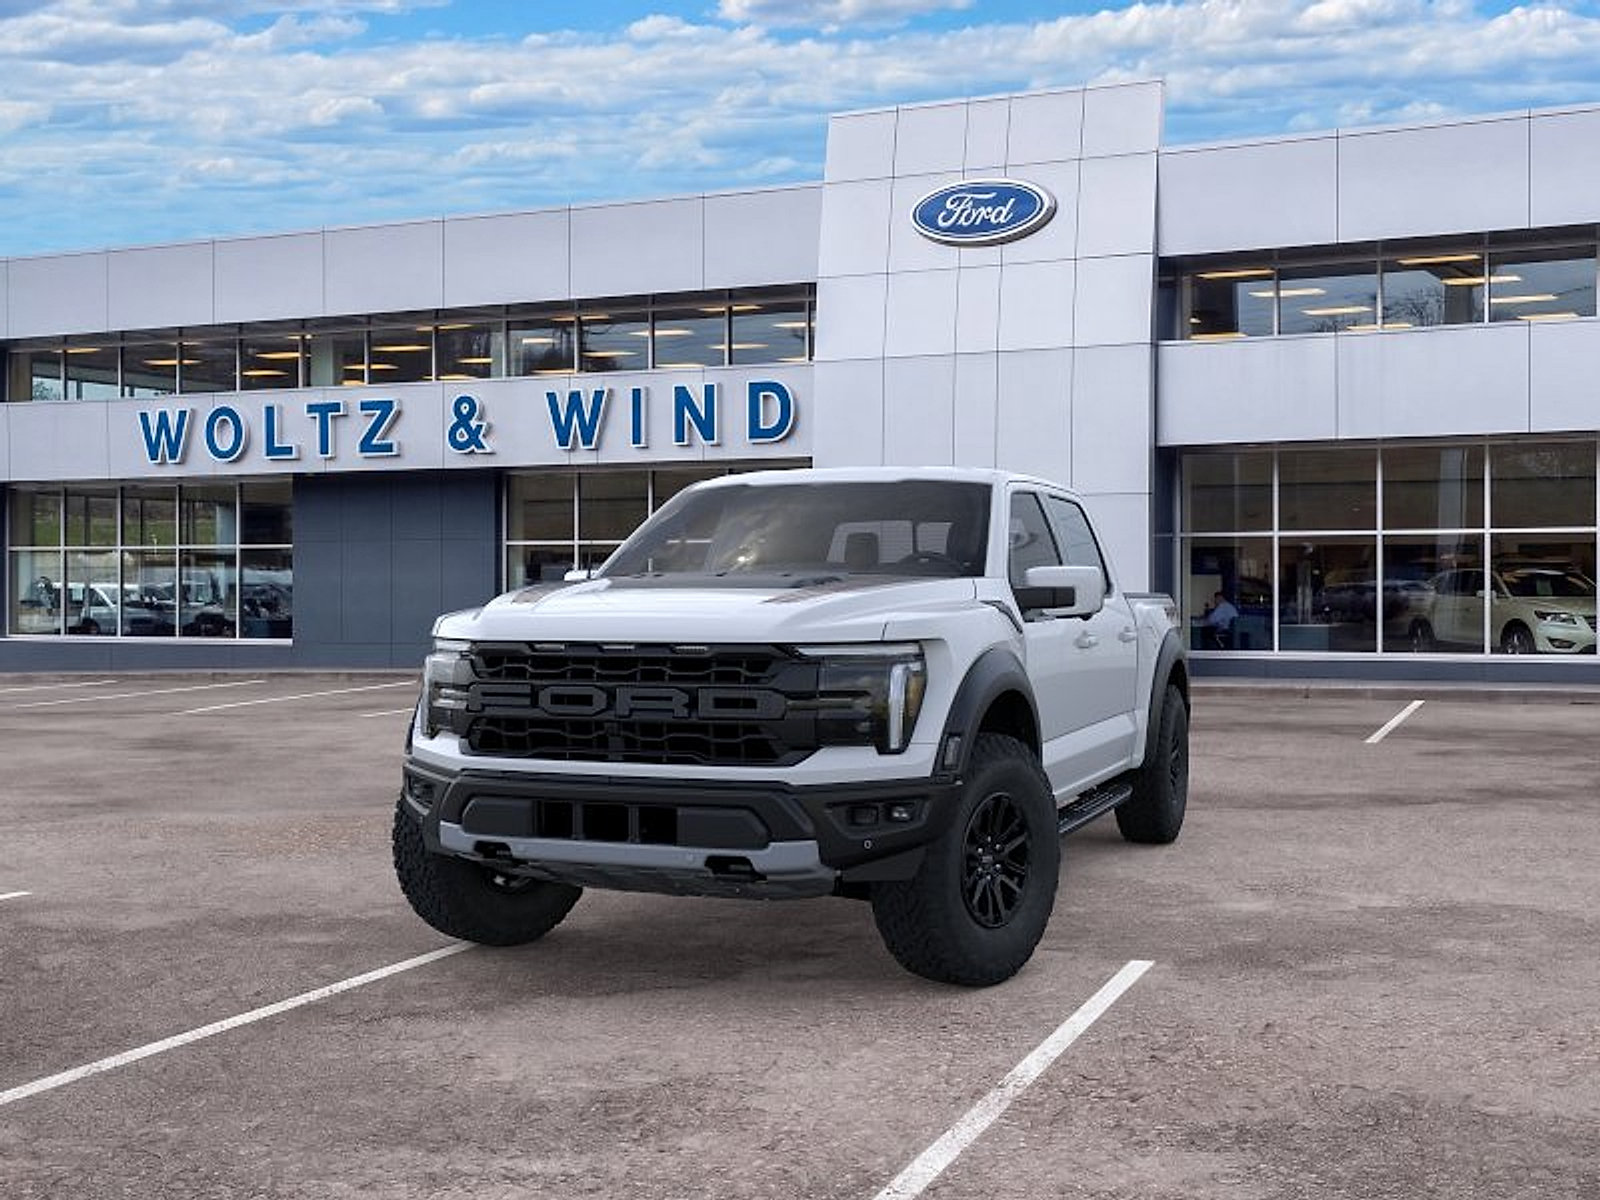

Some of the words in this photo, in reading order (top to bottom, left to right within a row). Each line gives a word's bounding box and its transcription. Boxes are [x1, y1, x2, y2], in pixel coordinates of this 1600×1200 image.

[937, 192, 1015, 228] Ford
[138, 398, 401, 465] WOLTZ
[446, 394, 494, 455] &
[545, 379, 797, 450] WIND
[467, 683, 787, 720] FORD
